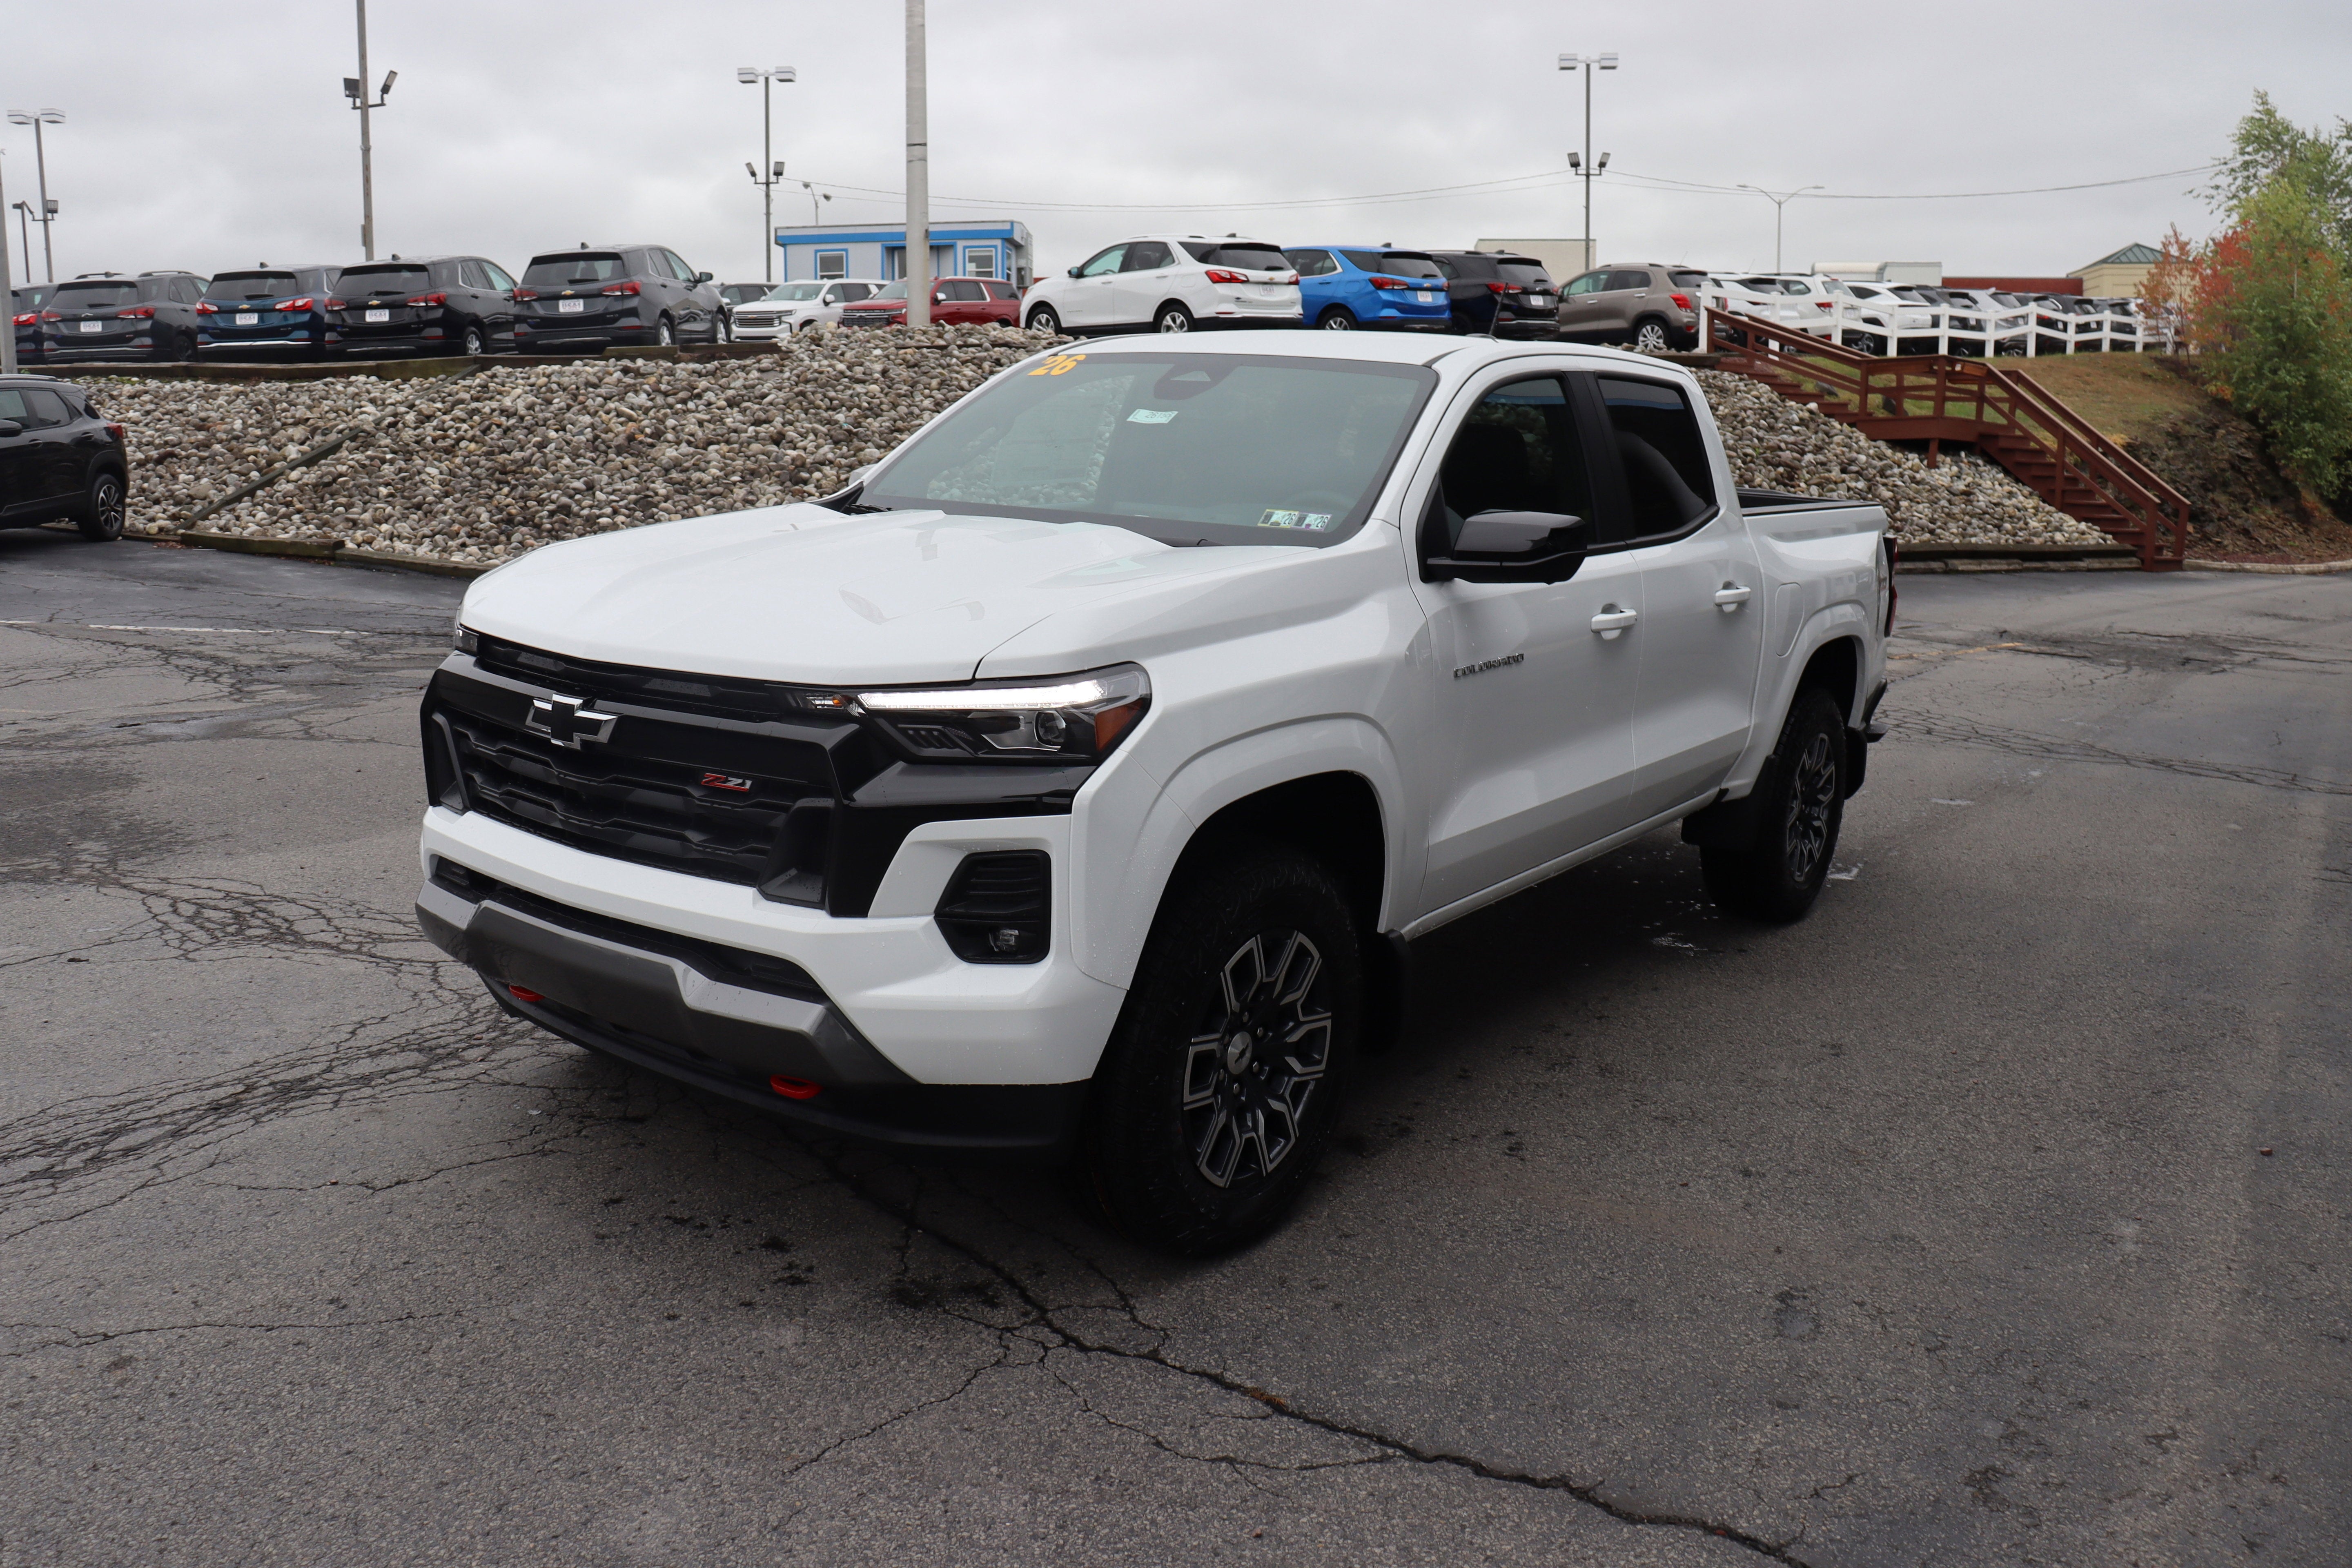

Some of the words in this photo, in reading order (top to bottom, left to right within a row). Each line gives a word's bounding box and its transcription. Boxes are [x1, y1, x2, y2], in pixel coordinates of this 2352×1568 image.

[1283, 513, 1296, 525] 26
[1315, 516, 1329, 528] 26
[1454, 653, 1524, 678] COLORADO
[701, 773, 752, 792] Z71
